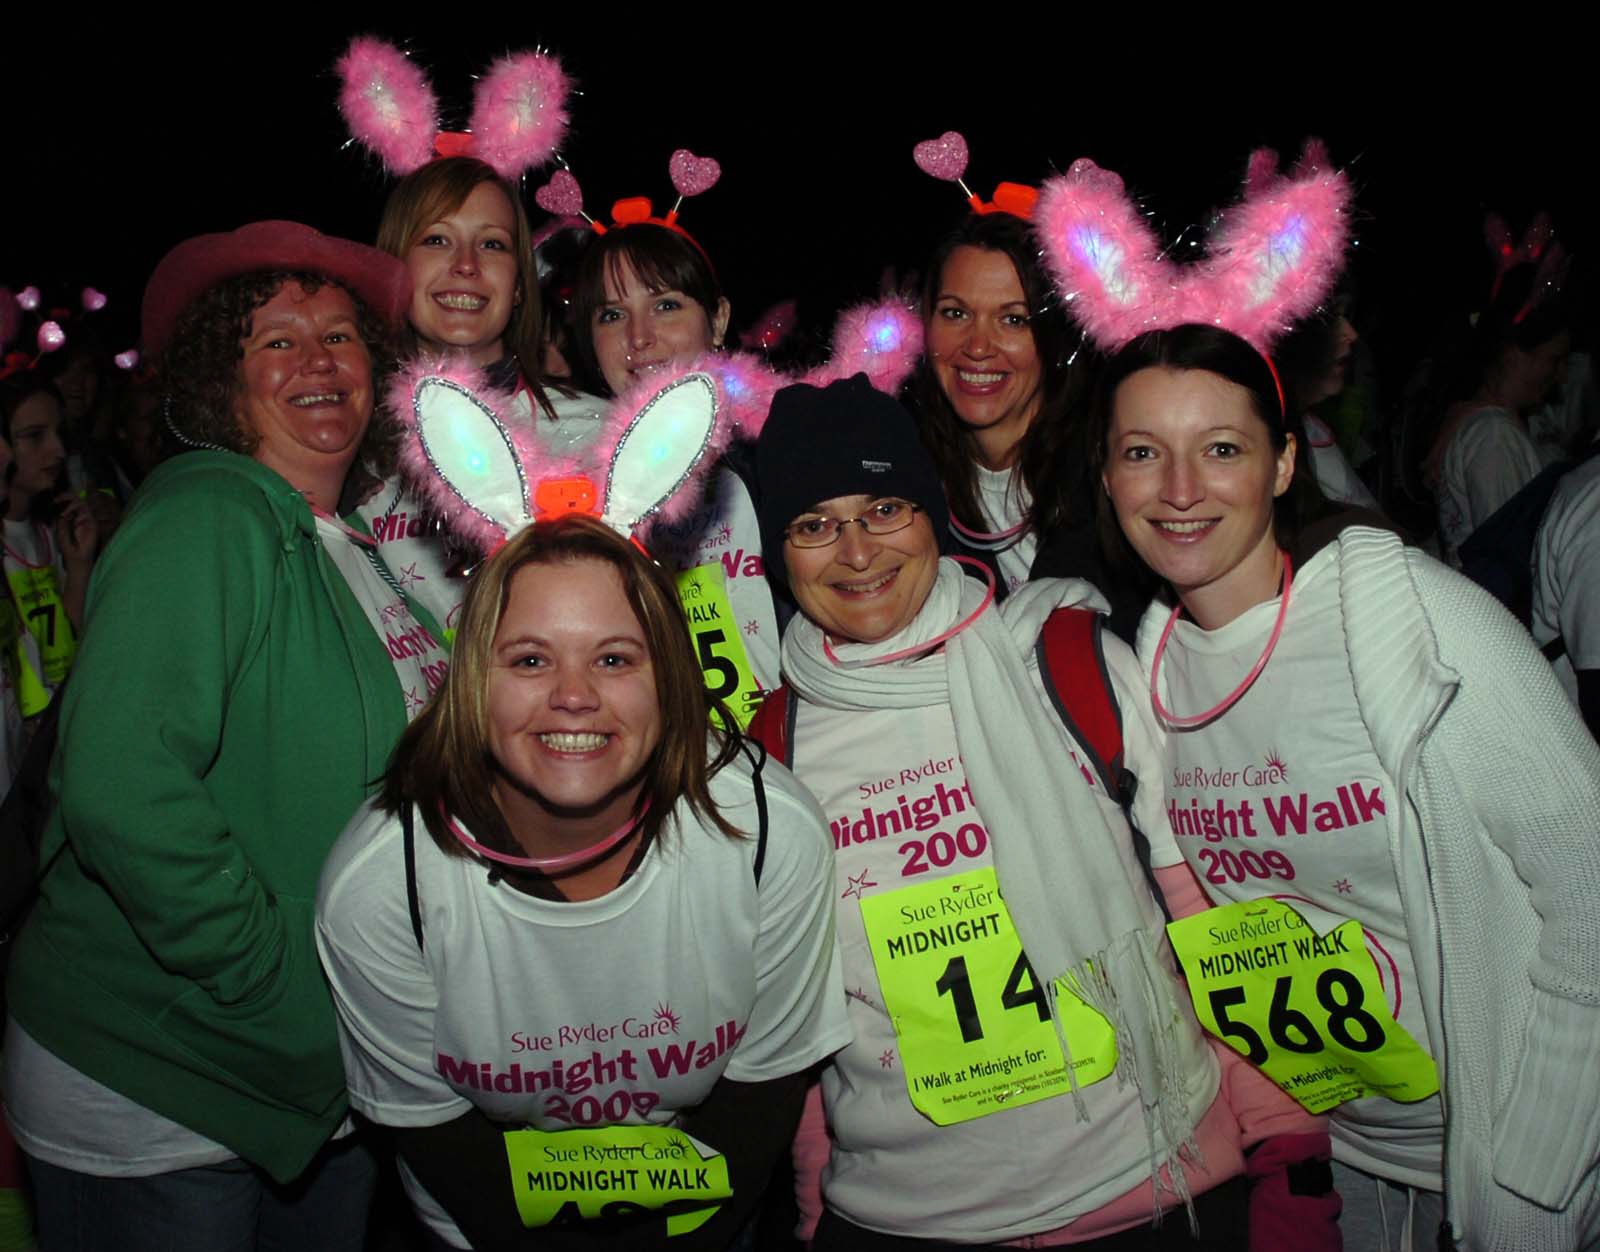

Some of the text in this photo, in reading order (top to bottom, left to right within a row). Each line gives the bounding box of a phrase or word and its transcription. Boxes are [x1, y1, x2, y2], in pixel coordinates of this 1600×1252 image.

[722, 549, 765, 578] Wa
[680, 585, 698, 601] are
[696, 628, 739, 701] 5
[859, 757, 954, 800] Sue Ryder
[1173, 765, 1279, 791] Sue Ryder Care
[1168, 782, 1386, 843] dnight Walk
[898, 823, 990, 877] 200
[1198, 848, 1296, 884] 2009
[900, 888, 993, 925] Sue Ryder
[887, 913, 1000, 959] MIDNIGHT
[1208, 911, 1307, 946] Sue Ryder Ca
[1199, 931, 1349, 979] MIDNIGHT WALK
[511, 1017, 671, 1053] Sue Ryder Care
[1208, 968, 1386, 1067] 568
[437, 1020, 748, 1095] Midnight Walk
[914, 1078, 920, 1092] I
[922, 1070, 952, 1091] Walk
[955, 1070, 967, 1083] at
[969, 1055, 1023, 1080] Midnight
[1025, 1049, 1047, 1064] for:
[544, 1143, 682, 1164] Sue Ryder Care
[527, 1168, 711, 1191] MIDNIGHT WALK
